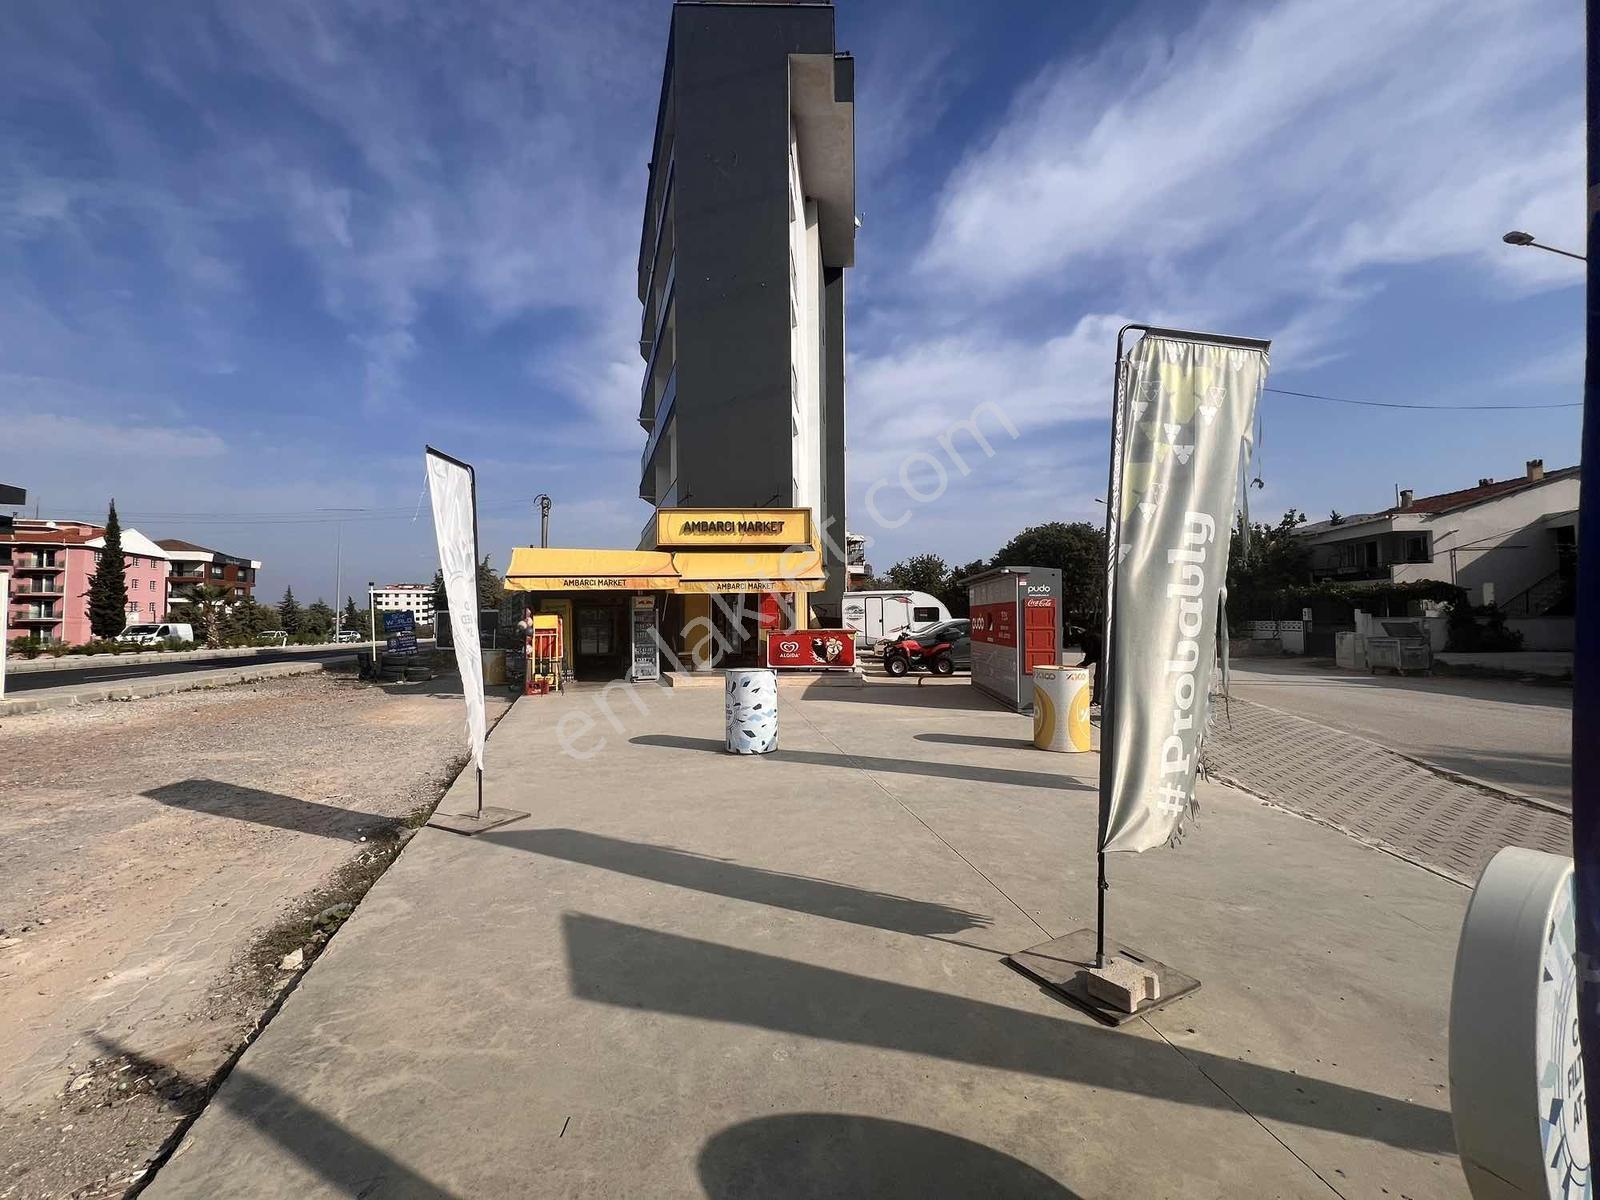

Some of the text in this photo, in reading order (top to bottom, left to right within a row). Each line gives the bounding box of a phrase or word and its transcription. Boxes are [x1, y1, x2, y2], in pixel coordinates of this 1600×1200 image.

[738, 521, 785, 533] MARKET
[563, 578, 627, 587] AMBARCI MARKET
[717, 582, 775, 591] AMBARCI MARKET
[1027, 583, 1051, 594] pudo
[1156, 511, 1217, 818] #Probably
